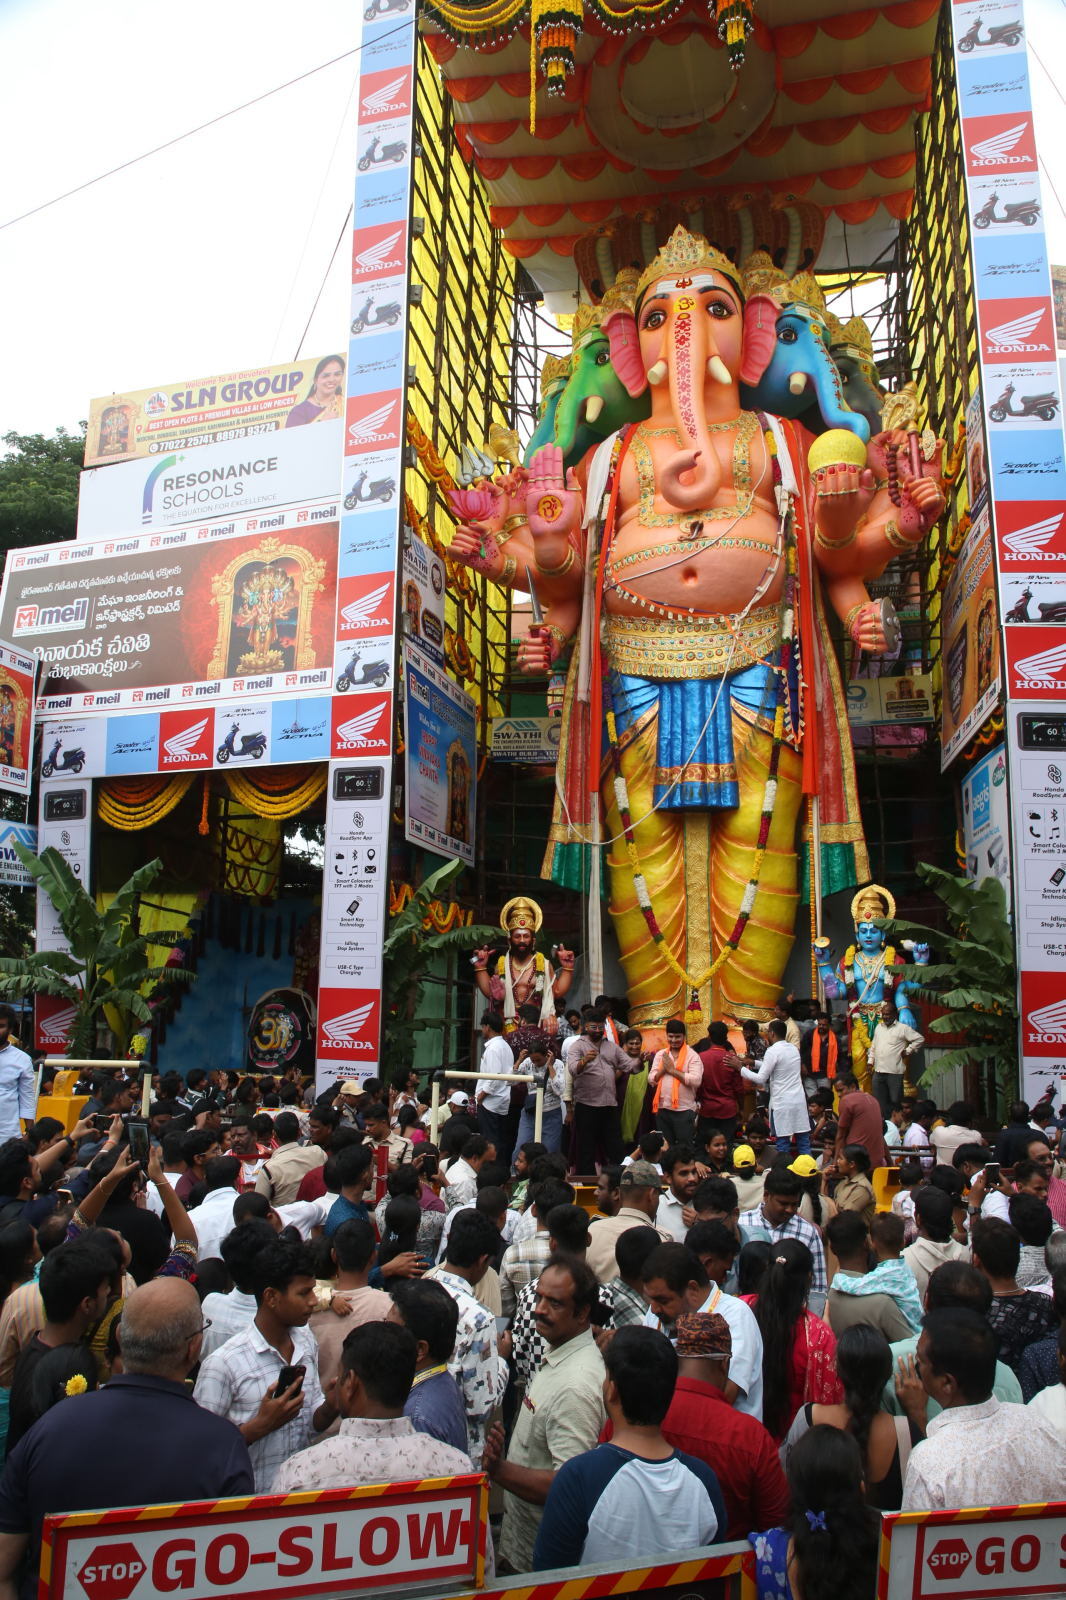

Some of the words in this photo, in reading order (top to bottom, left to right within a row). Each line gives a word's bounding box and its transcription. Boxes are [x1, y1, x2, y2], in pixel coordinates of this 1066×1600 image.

[362, 103, 408, 117] HONDA
[972, 155, 1033, 167] HONDA
[355, 260, 402, 275] HONDA
[987, 343, 1050, 354] HONDA
[171, 386, 216, 412] SLN
[221, 371, 304, 402] GROUP
[232, 406, 251, 414] VILLAS
[159, 439, 185, 452] 77022
[247, 422, 276, 436] 93274
[349, 432, 396, 446] HONDA
[162, 457, 278, 492] RESONANCE
[162, 482, 244, 510] SCHOOLS
[162, 512, 181, 520] THE
[183, 505, 214, 518] EQUATION
[214, 502, 230, 512] FOR
[230, 494, 277, 508] EXCELLENCE
[27, 554, 49, 565] meil
[71, 547, 93, 559] meil
[116, 540, 139, 552] meil
[163, 532, 187, 545] meil
[211, 524, 234, 536] meil
[260, 515, 285, 528] meil
[311, 506, 337, 519] meil
[1003, 553, 1066, 561] HONDA
[175, 587, 184, 596] &
[40, 600, 88, 625] meil
[340, 617, 390, 630] HONDA
[107, 633, 150, 653] చవితి
[18, 659, 32, 670] meil
[48, 697, 72, 709] meil
[96, 693, 120, 705] meil
[146, 689, 170, 700] meil
[196, 683, 220, 696] meil
[247, 677, 273, 690] meil
[300, 672, 326, 684] meil
[336, 739, 388, 750] HONDA
[163, 752, 209, 764] HONDA
[10, 772, 25, 780] meil
[322, 1040, 374, 1050] HONDA
[930, 1553, 970, 1566] STOP
[975, 1534, 1041, 1575] GO
[83, 1562, 143, 1584] STOP
